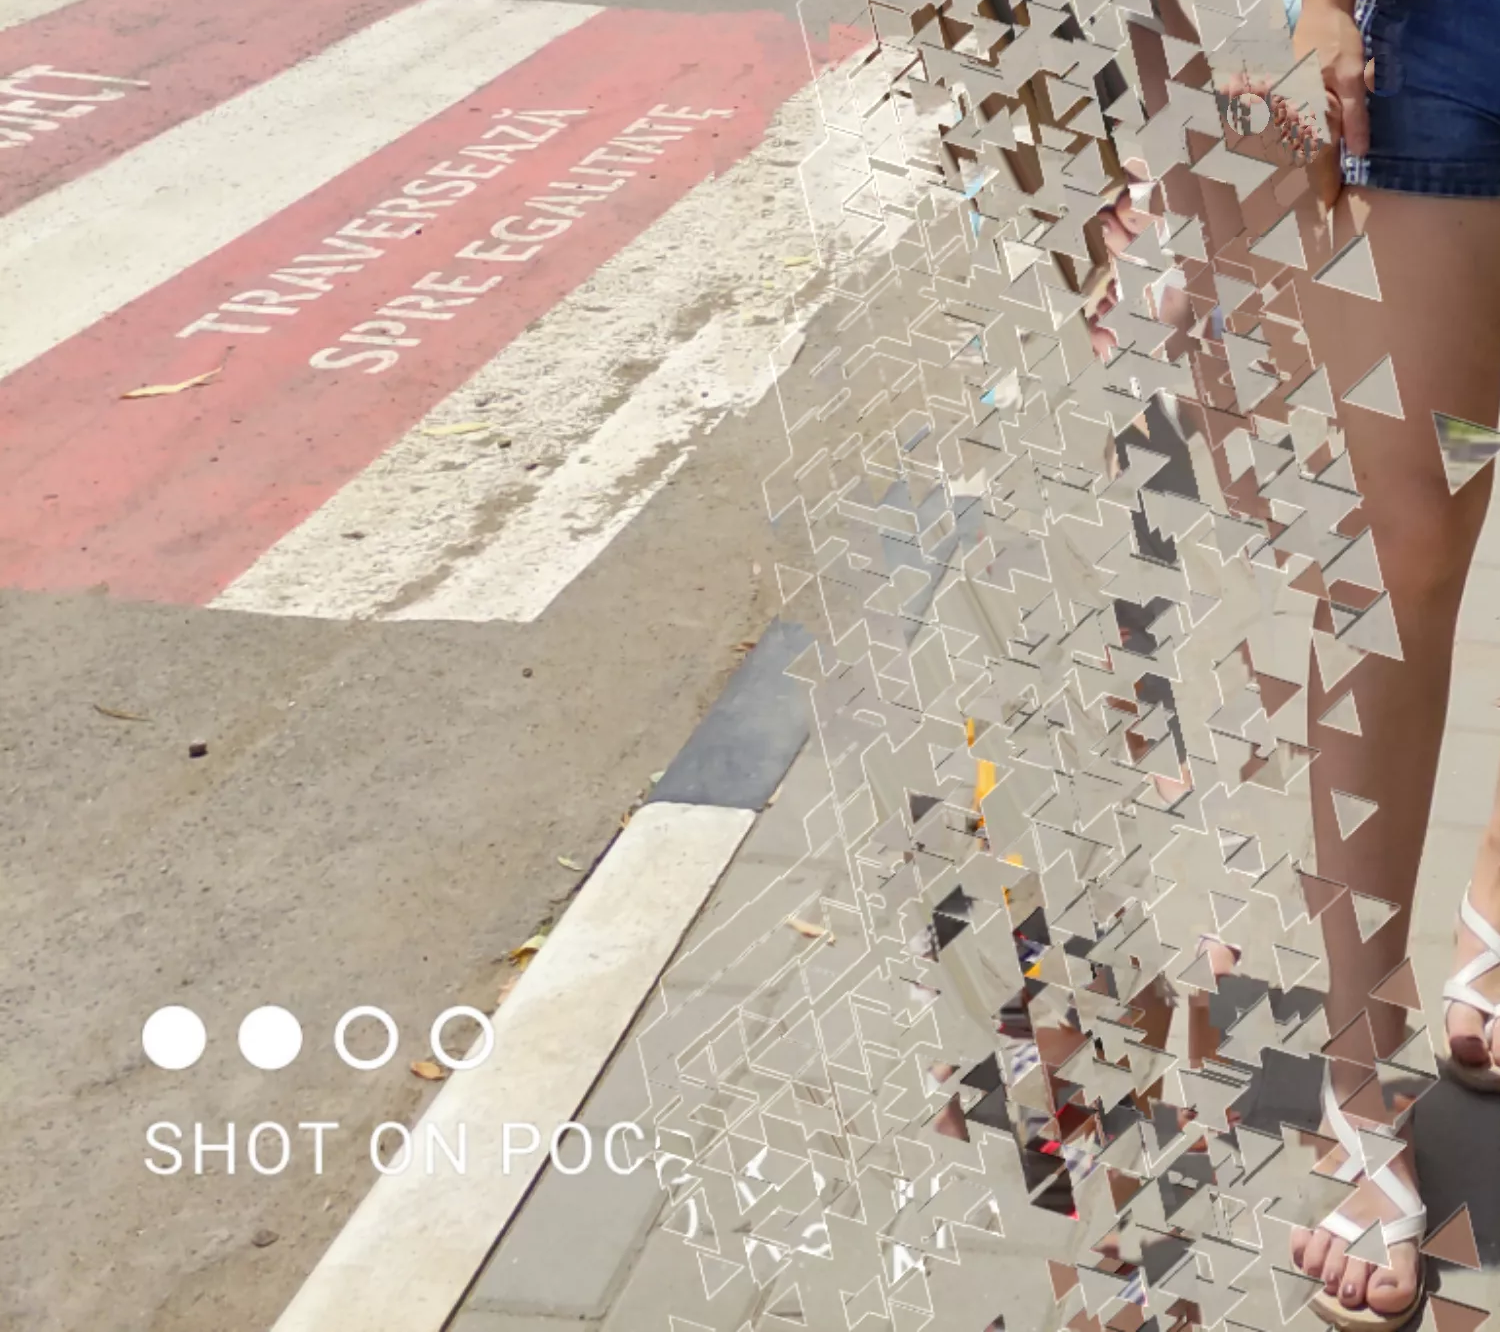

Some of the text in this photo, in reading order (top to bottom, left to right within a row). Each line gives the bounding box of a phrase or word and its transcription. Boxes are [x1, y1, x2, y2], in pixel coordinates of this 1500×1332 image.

[176, 108, 589, 338] TRAVERSEAZĂ
[309, 103, 734, 374] SPRE EGALITATE
